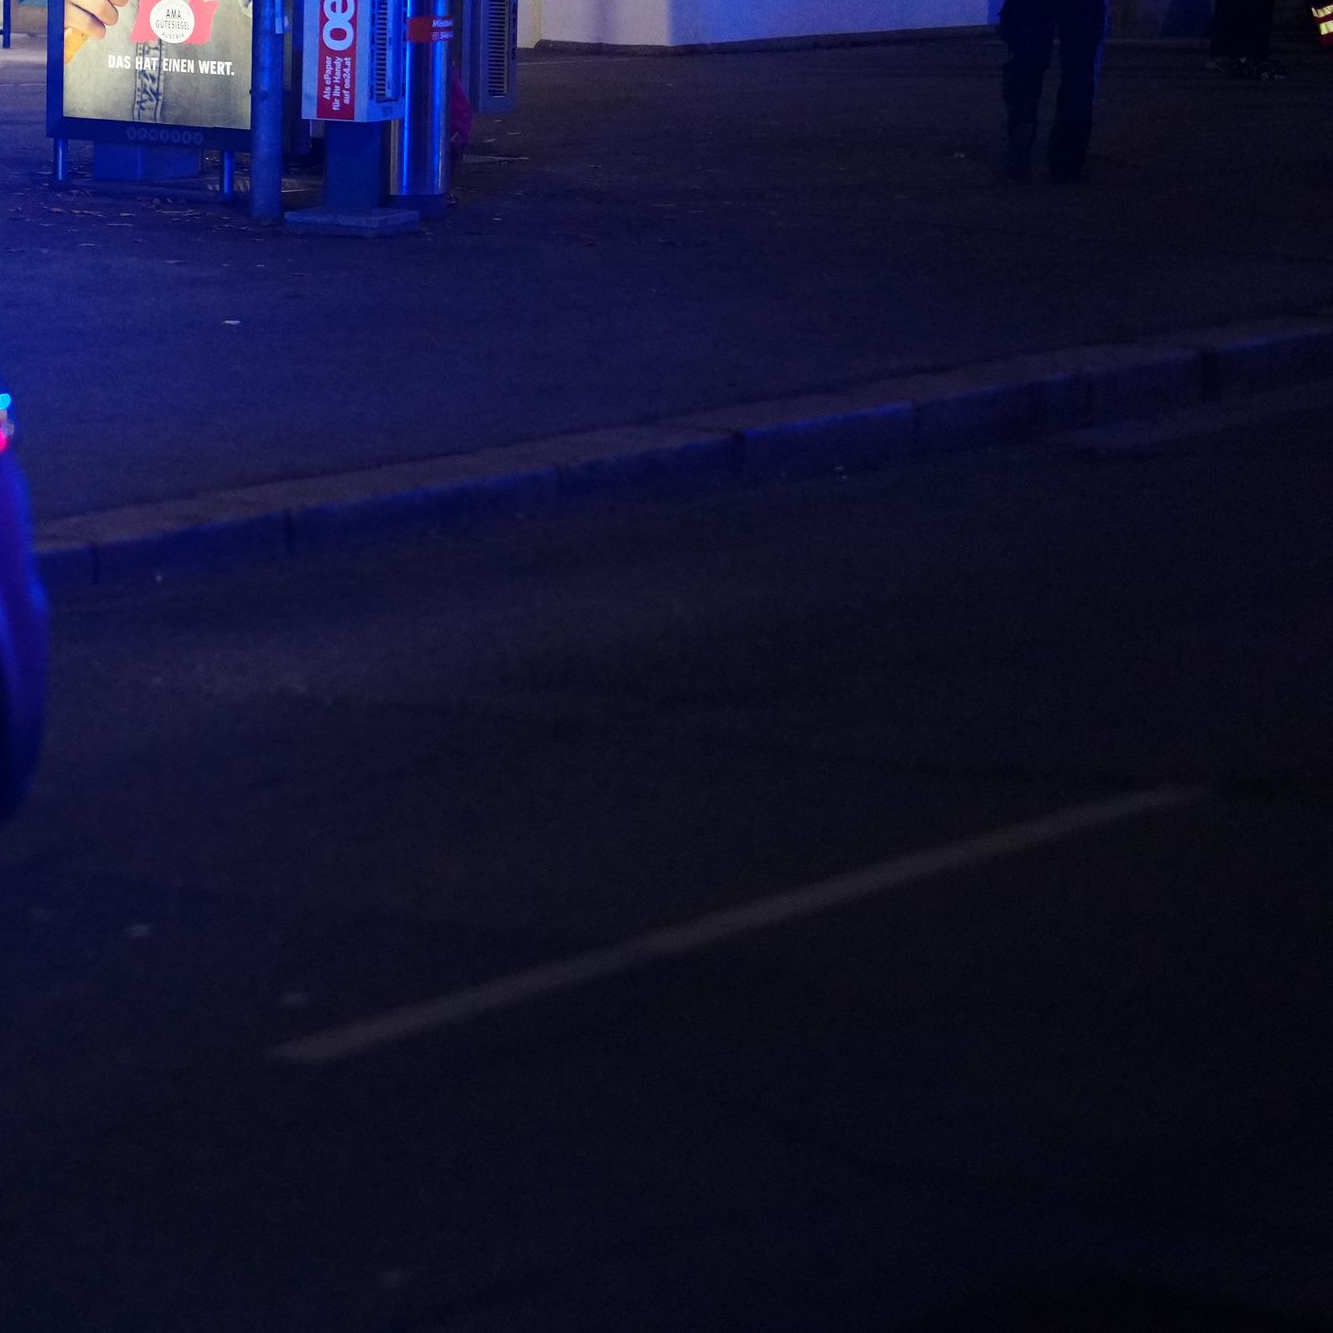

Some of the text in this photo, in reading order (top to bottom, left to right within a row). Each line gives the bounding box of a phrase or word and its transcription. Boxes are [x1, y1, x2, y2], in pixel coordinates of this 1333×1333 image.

[165, 8, 182, 19] AMA
[108, 55, 235, 76] DAS HAT EINEN WERT.
[323, 56, 334, 100] Als ePaper
[332, 56, 343, 111] für Ihr Handy
[342, 57, 351, 105] auf oe24.at
